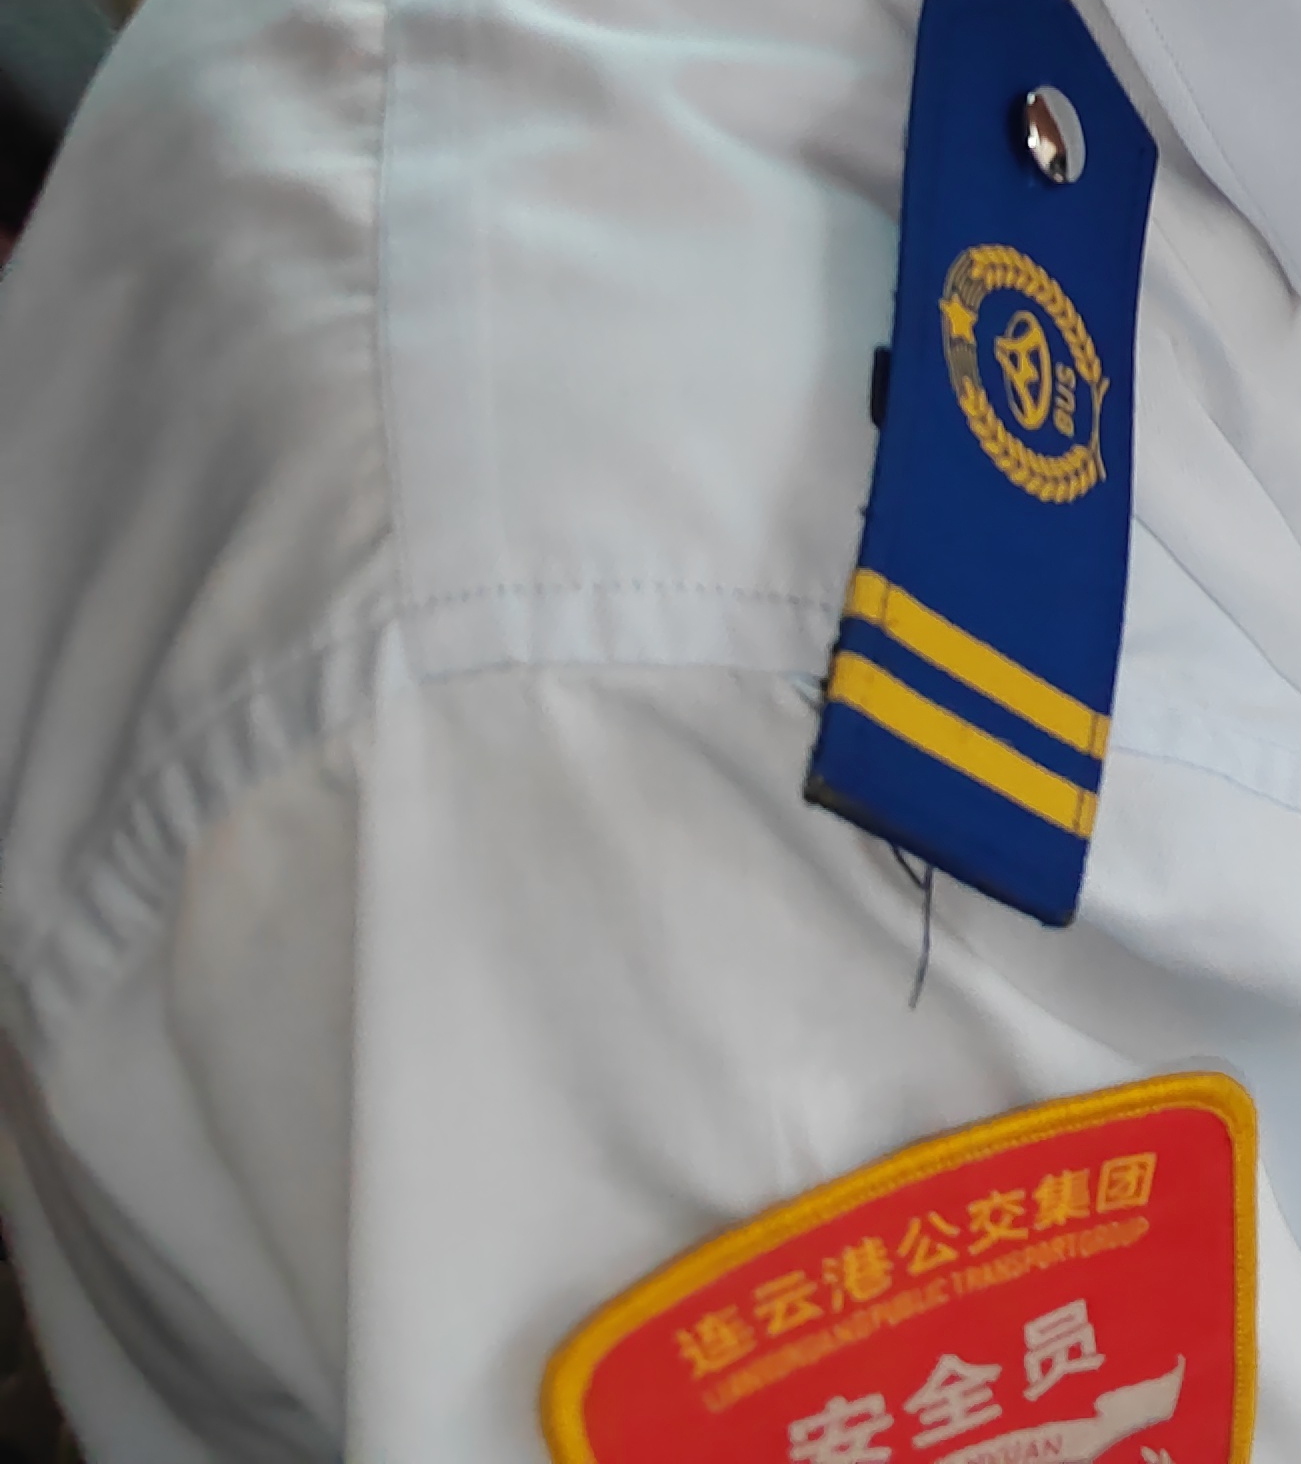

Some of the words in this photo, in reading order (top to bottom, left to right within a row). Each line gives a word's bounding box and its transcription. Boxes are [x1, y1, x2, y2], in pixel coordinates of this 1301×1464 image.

[1053, 361, 1076, 438] BUS
[676, 1150, 1159, 1381] 连云港公交集团
[788, 1297, 1108, 1464] 安全员
